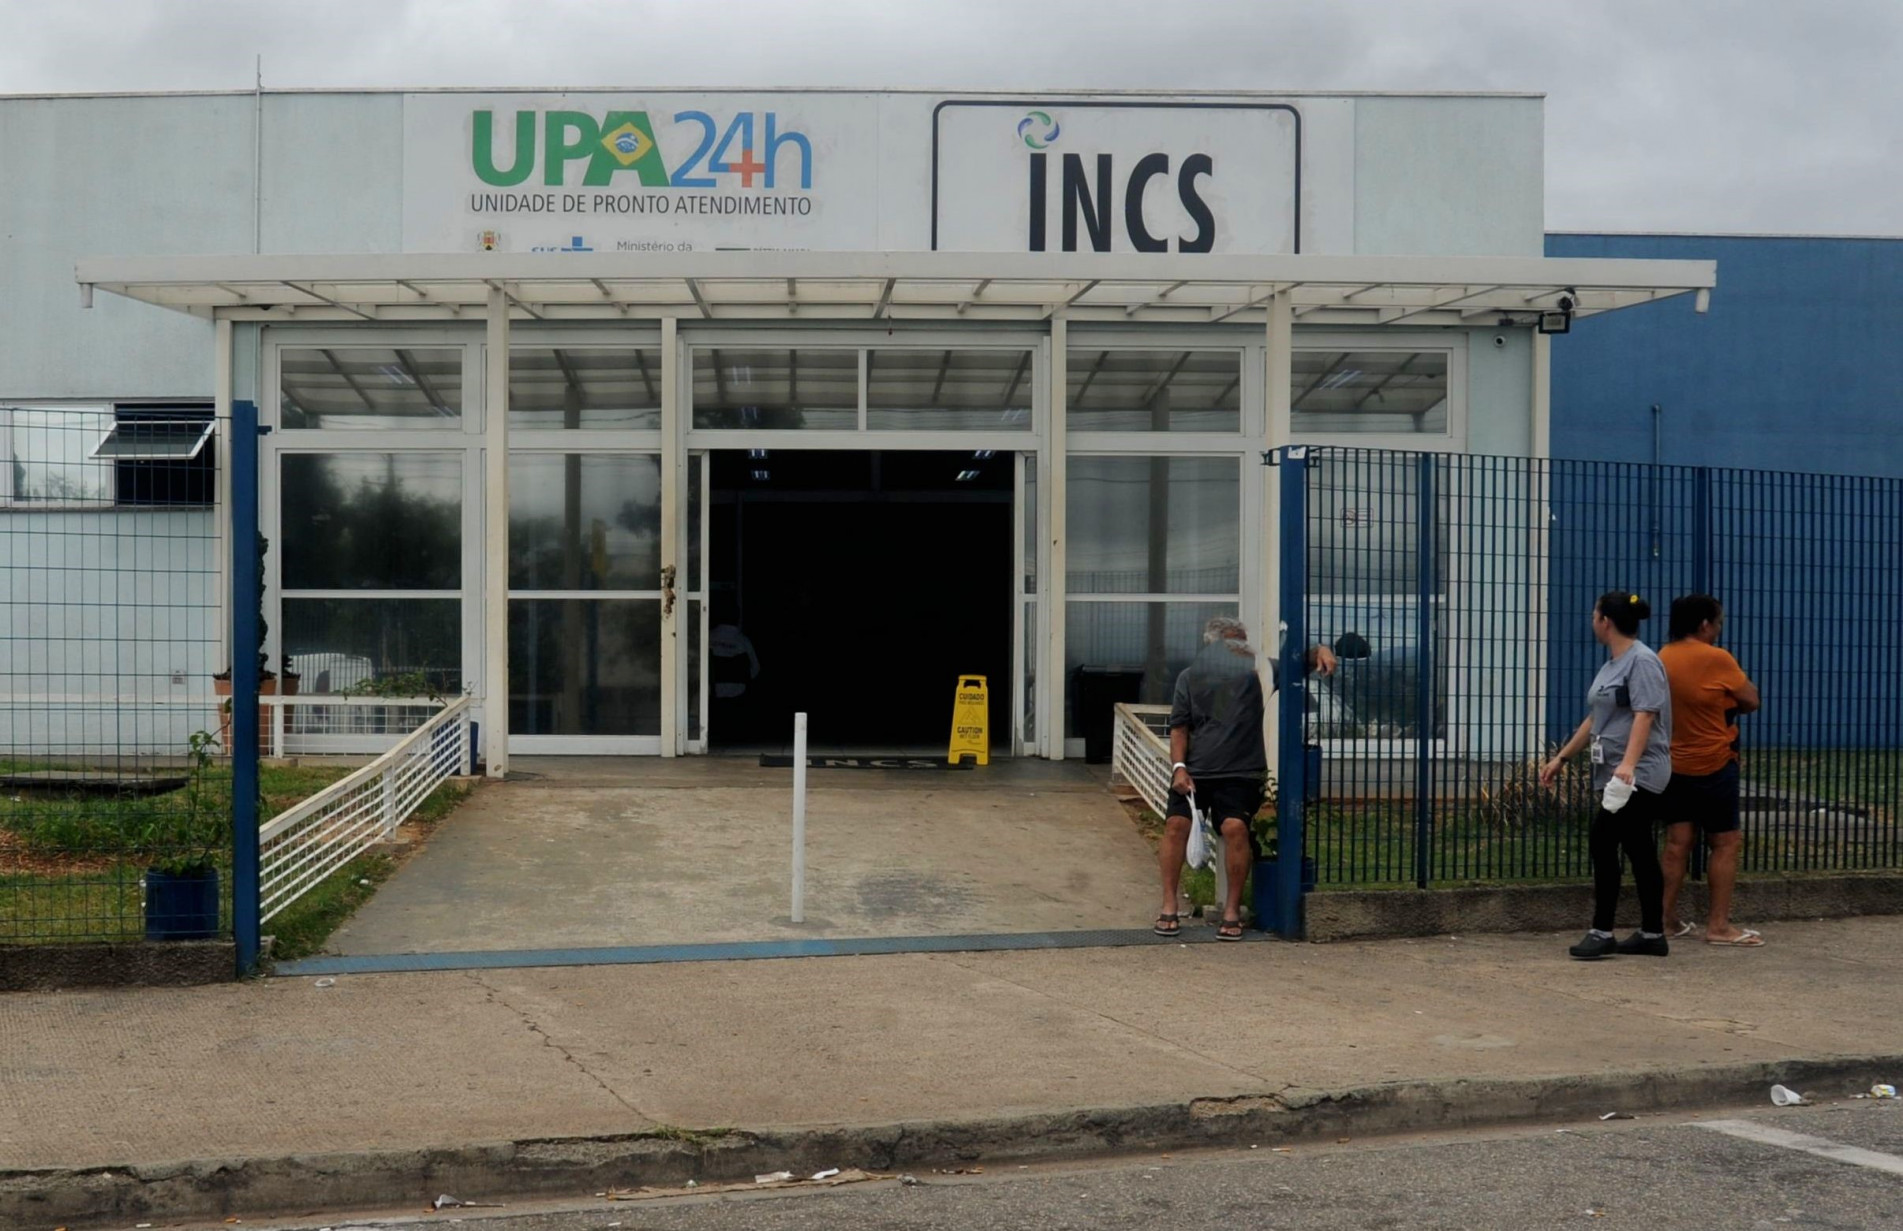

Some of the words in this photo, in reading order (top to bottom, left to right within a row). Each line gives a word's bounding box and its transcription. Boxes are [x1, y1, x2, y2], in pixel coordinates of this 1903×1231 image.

[472, 109, 669, 187] UPA
[670, 110, 812, 189] 24h
[471, 194, 555, 212] UNIDADE
[562, 195, 587, 213] DE
[593, 195, 669, 214] PRONTO
[674, 196, 811, 215] ATENDIMENTO
[1029, 153, 1215, 253] INCS
[616, 240, 680, 251] Ministério
[682, 241, 693, 251] da
